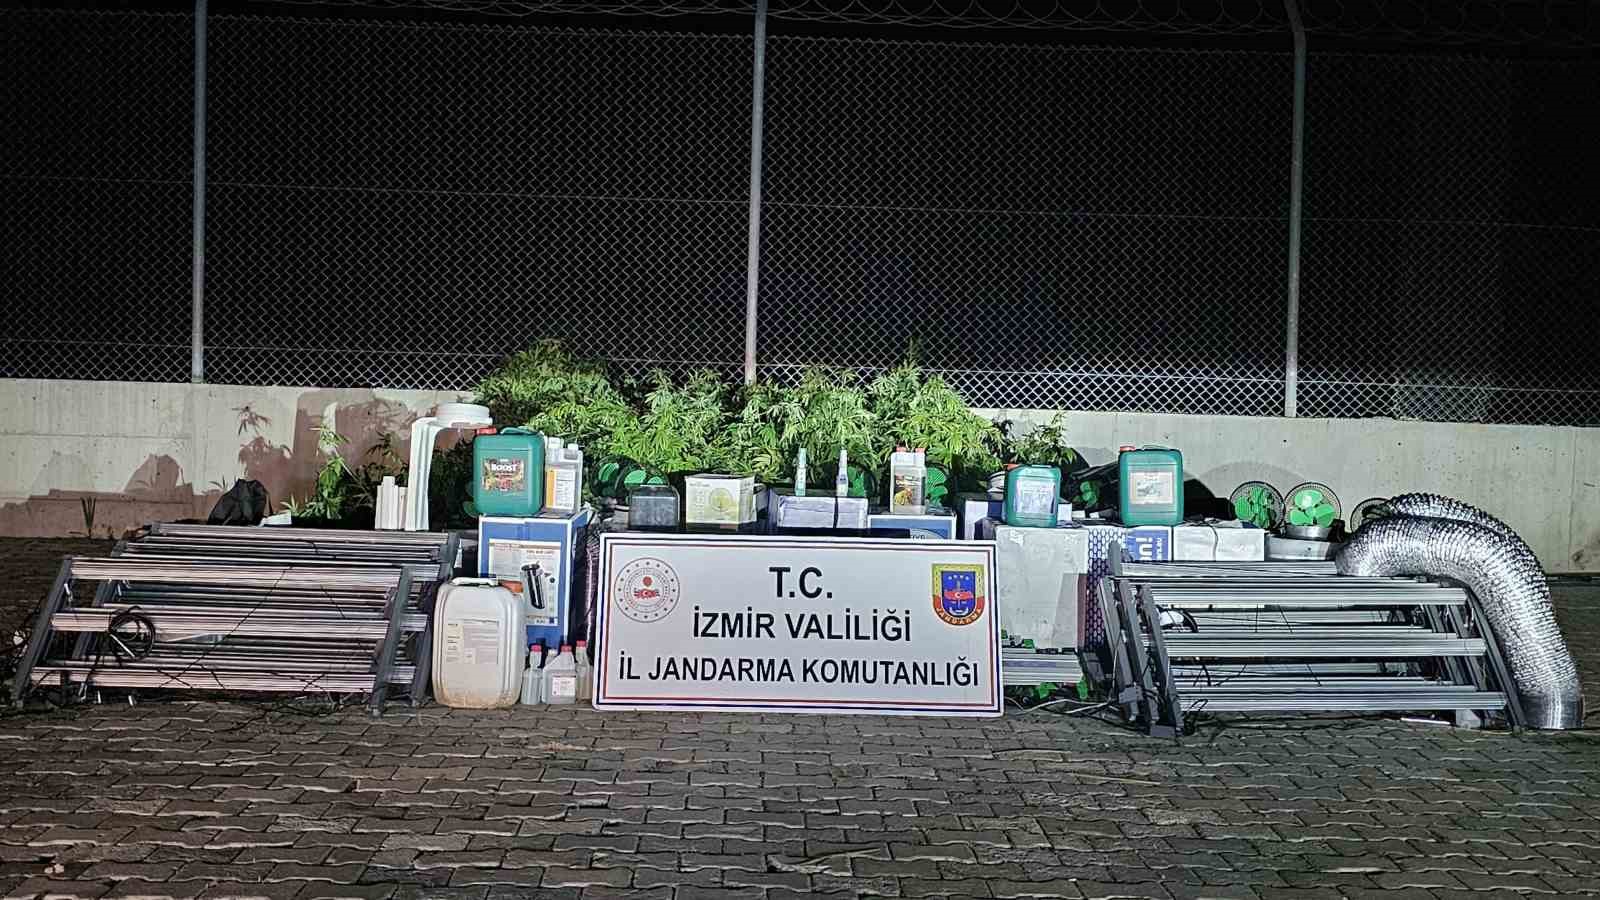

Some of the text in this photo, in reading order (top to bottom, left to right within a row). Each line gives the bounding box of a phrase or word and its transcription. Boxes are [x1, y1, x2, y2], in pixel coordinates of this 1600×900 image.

[491, 463, 517, 471] BOOST
[769, 567, 833, 599] T.C.
[694, 606, 911, 641] İZMİR VALİLİĞİ
[619, 650, 979, 687] İL JANDARMA KOMUTANLIĞI
